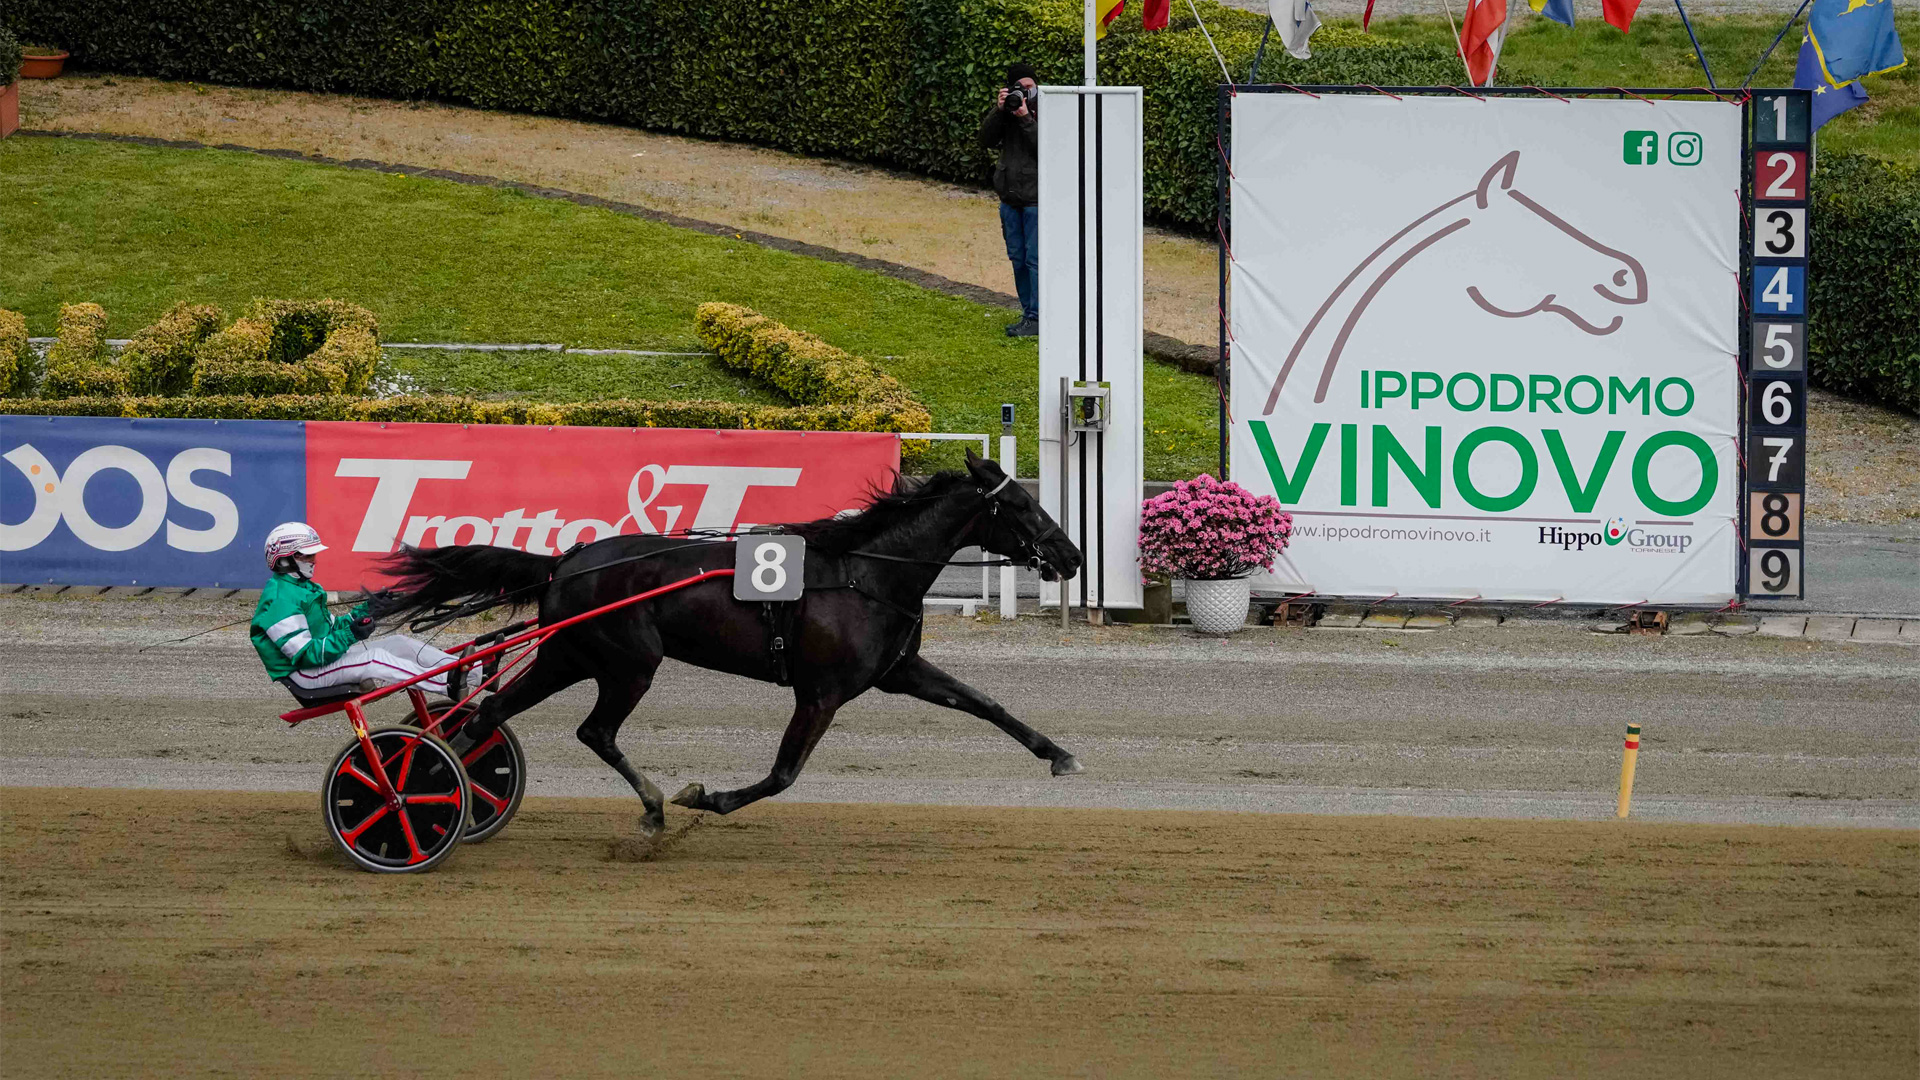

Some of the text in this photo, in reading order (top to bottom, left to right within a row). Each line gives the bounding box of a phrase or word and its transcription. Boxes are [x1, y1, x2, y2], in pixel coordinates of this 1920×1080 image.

[1771, 96, 1787, 141] 1
[1765, 152, 1797, 198] 2
[1764, 210, 1795, 254] 3
[1762, 267, 1793, 311] 4
[1762, 324, 1794, 369] 5
[1361, 370, 1695, 417] IPPODROMO
[1761, 381, 1792, 425] 6
[1247, 420, 1719, 517] VINOVO
[1762, 437, 1794, 482] 7
[1289, 523, 1492, 543] ww.ippodromovinovo.it
[1760, 493, 1790, 537] 8
[1538, 526, 1693, 553] Hippo Group
[751, 542, 787, 593] 8
[1760, 550, 1791, 593] 9
